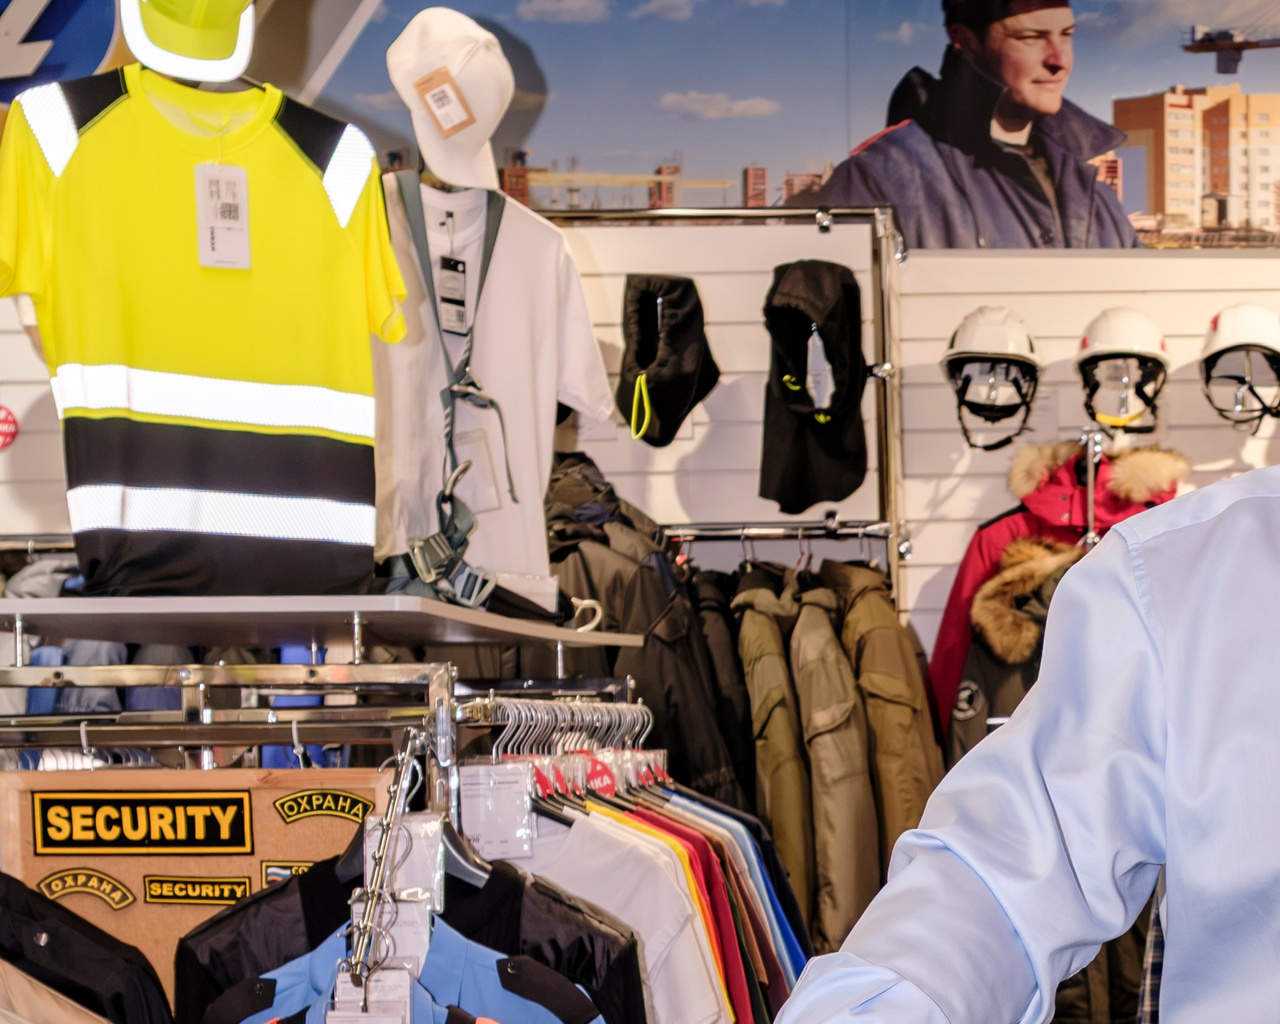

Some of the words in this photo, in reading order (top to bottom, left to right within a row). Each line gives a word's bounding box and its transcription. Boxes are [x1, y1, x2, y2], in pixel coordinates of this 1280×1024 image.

[283, 794, 363, 819] ОХРАНА
[46, 805, 238, 841] SECURITY
[50, 874, 126, 903] ОХРАНА
[149, 882, 246, 898] SECURITY
